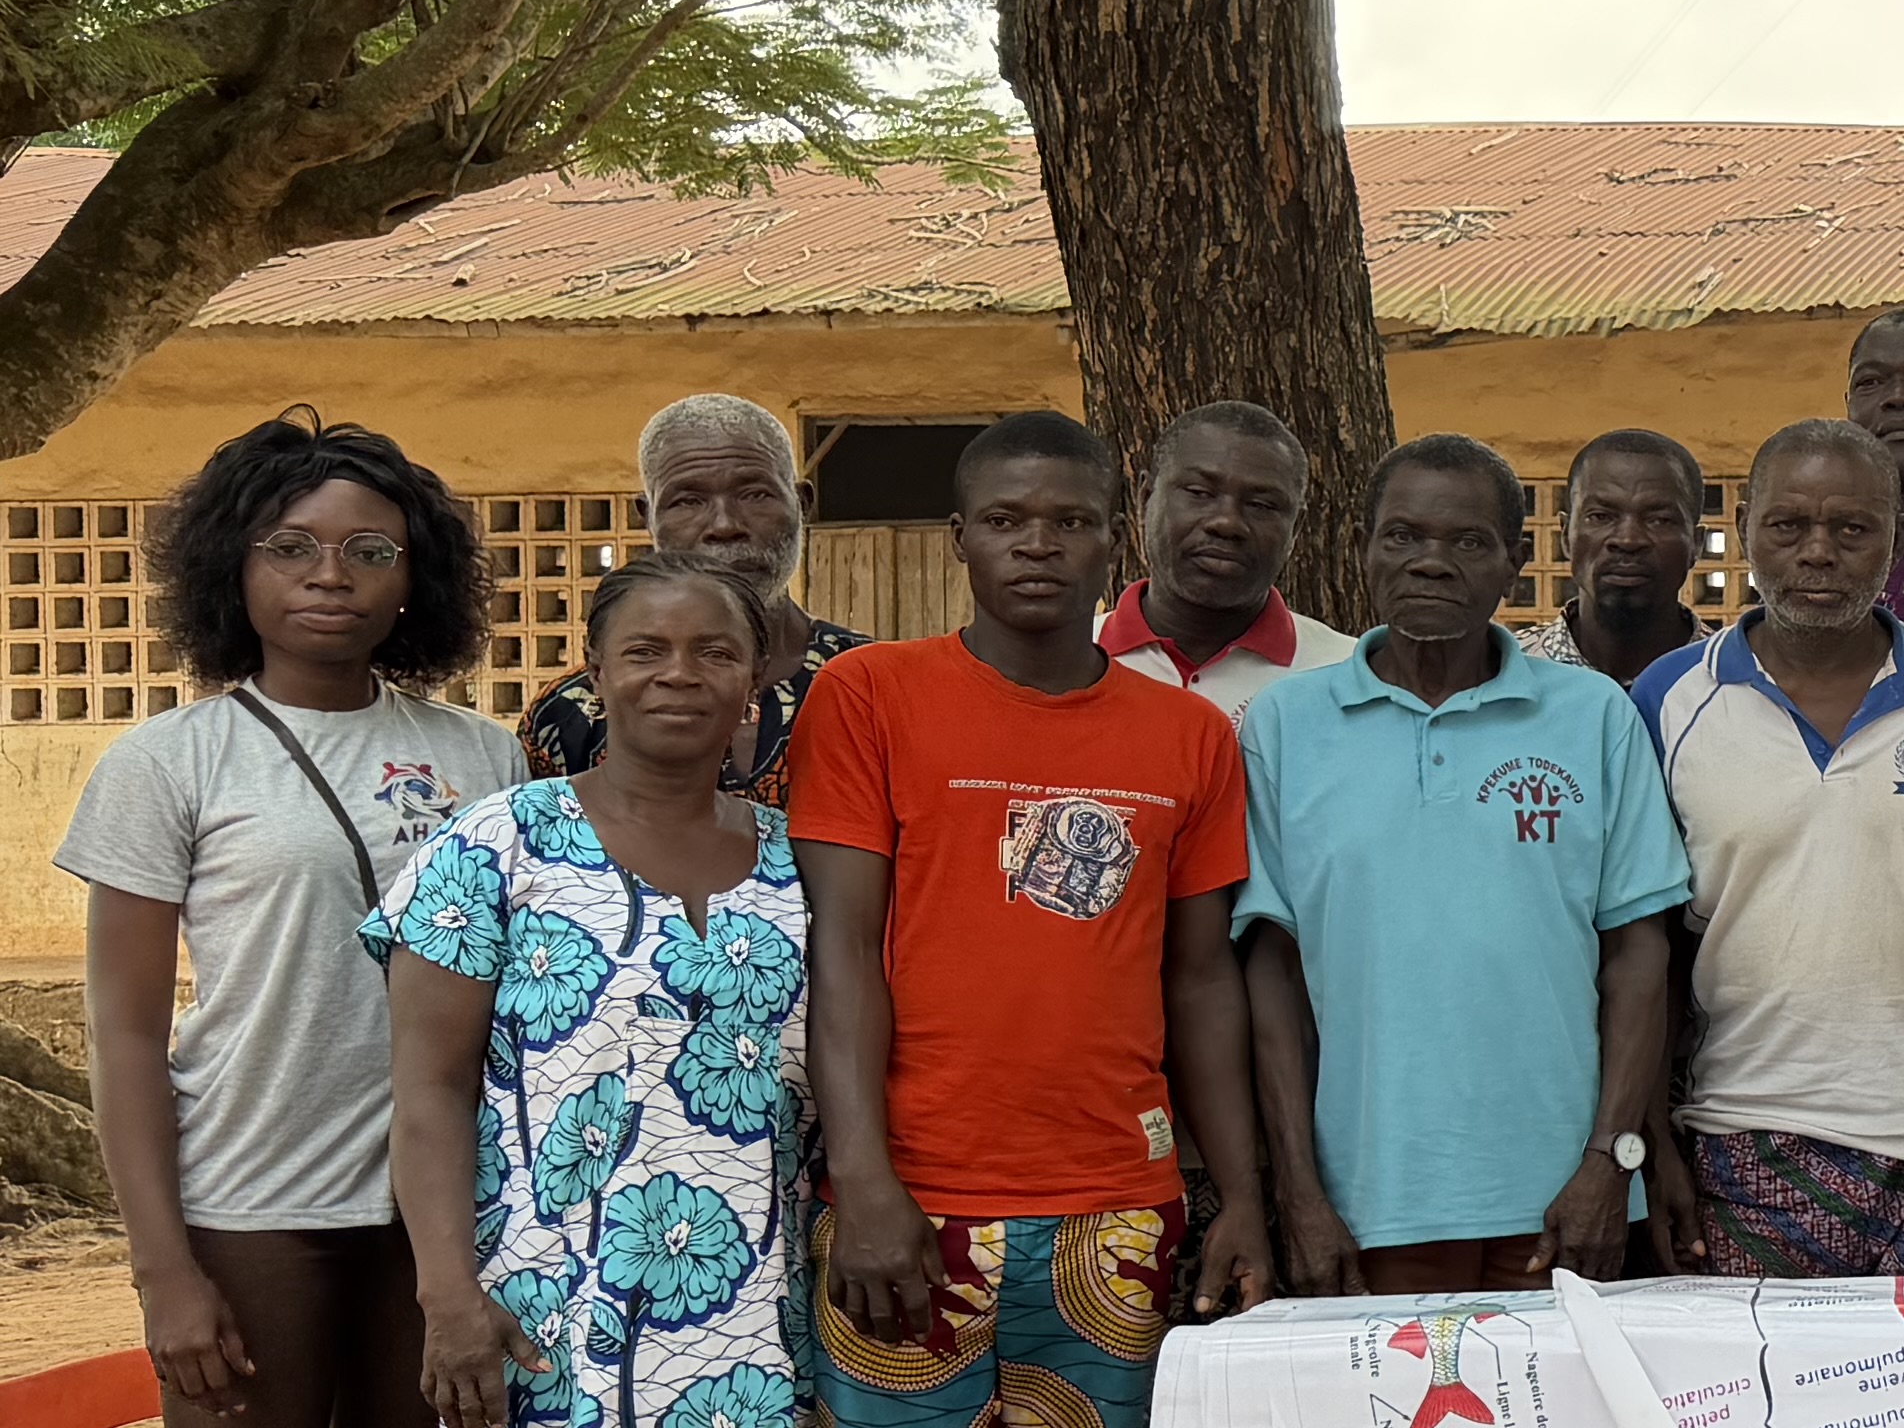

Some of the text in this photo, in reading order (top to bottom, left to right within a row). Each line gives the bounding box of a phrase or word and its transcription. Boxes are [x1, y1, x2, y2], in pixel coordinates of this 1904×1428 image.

[1476, 757, 1584, 804] KPEKUME TODEKAVIO
[1514, 810, 1561, 843] KT
[1350, 1336, 1363, 1371] anale
[1526, 1352, 1545, 1411] Nageoire
[1496, 1382, 1510, 1419] Ligne
